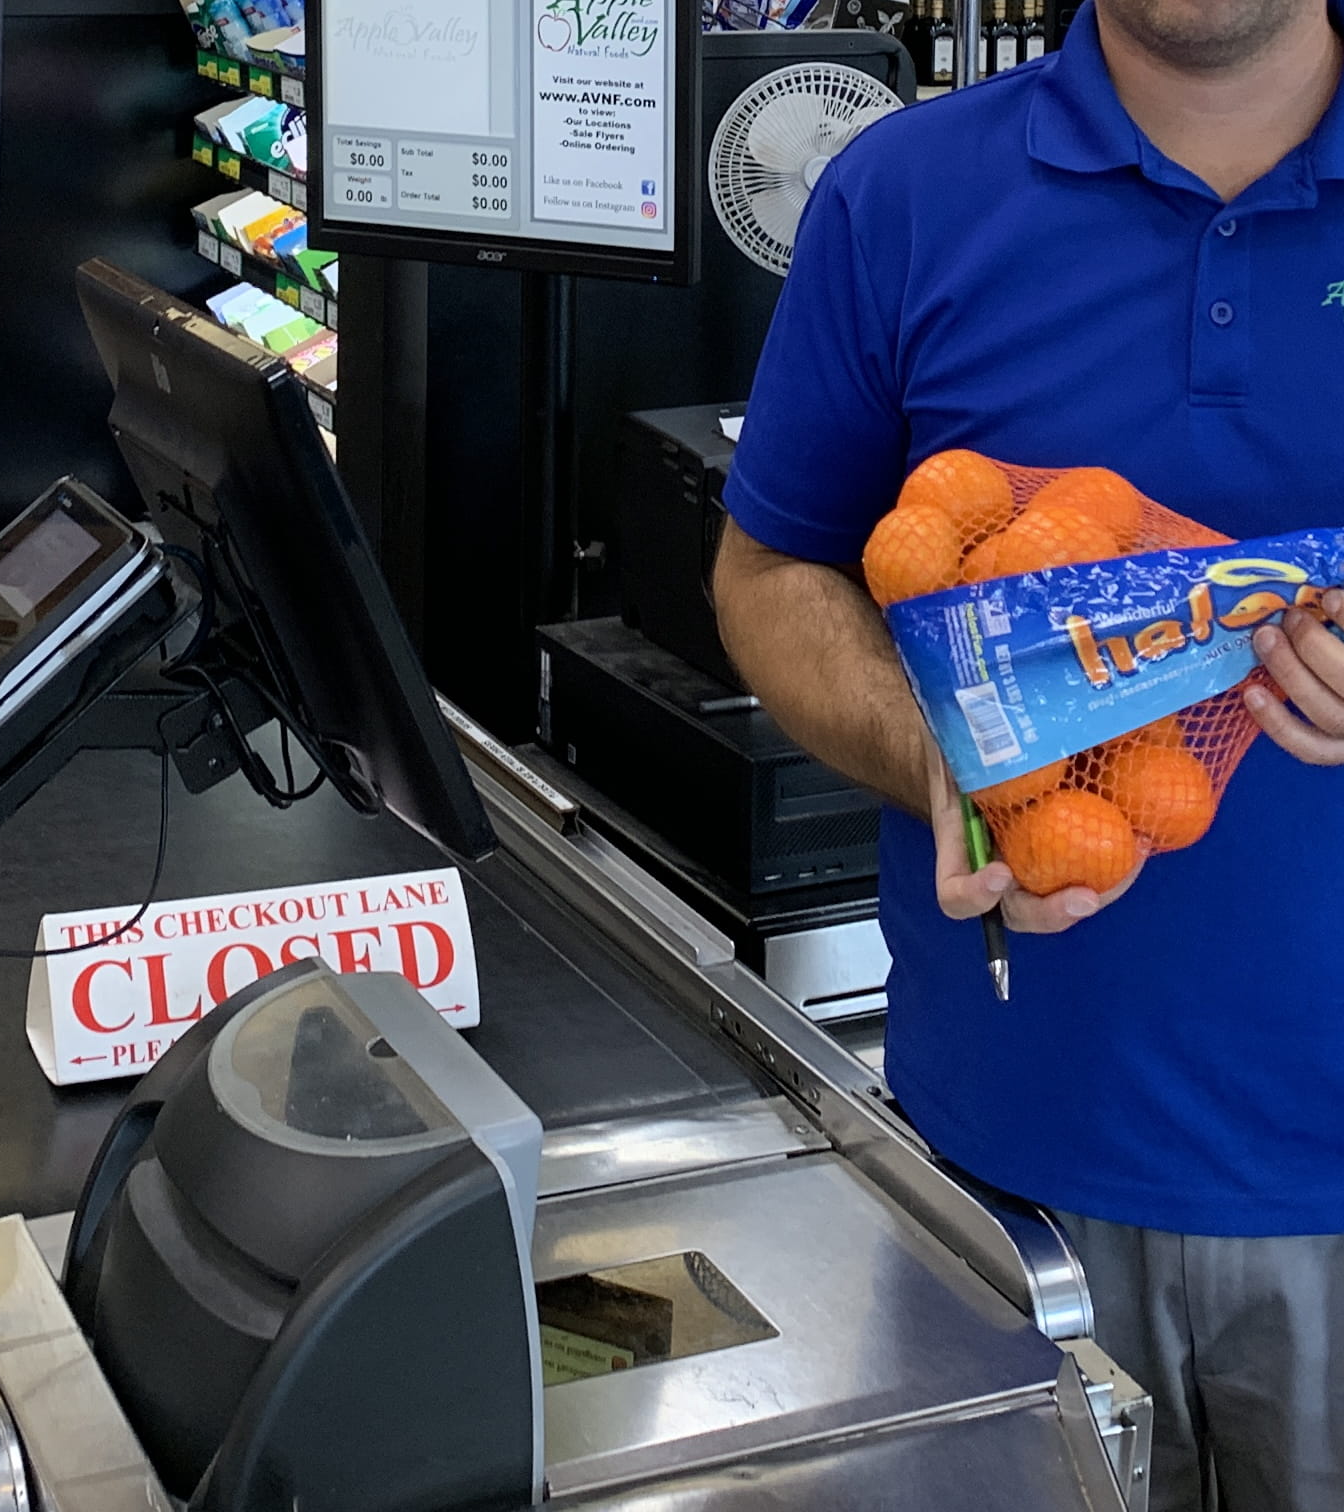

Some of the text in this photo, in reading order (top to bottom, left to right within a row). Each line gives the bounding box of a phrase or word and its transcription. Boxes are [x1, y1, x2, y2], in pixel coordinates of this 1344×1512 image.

[568, 11, 658, 57] Valley
[568, 46, 629, 59] Natural Foods
[552, 75, 644, 89] Visit our website at
[539, 91, 656, 108] www.AVNF.com
[579, 107, 588, 115] to
[585, 118, 631, 130] Locations
[596, 131, 625, 141] Flyers
[594, 142, 636, 154] Ordering
[350, 152, 384, 167] $0.00
[417, 149, 434, 157] Total
[472, 152, 508, 167] $0.00
[401, 169, 508, 188] Tax $0.00
[543, 175, 623, 190] Like us on Facebook
[346, 189, 373, 203] 0.00
[472, 196, 508, 211] $0.00
[543, 195, 635, 213] Follow us on Instagram
[477, 250, 508, 262] acer
[61, 881, 449, 950] THIS CHECKOUT LANE
